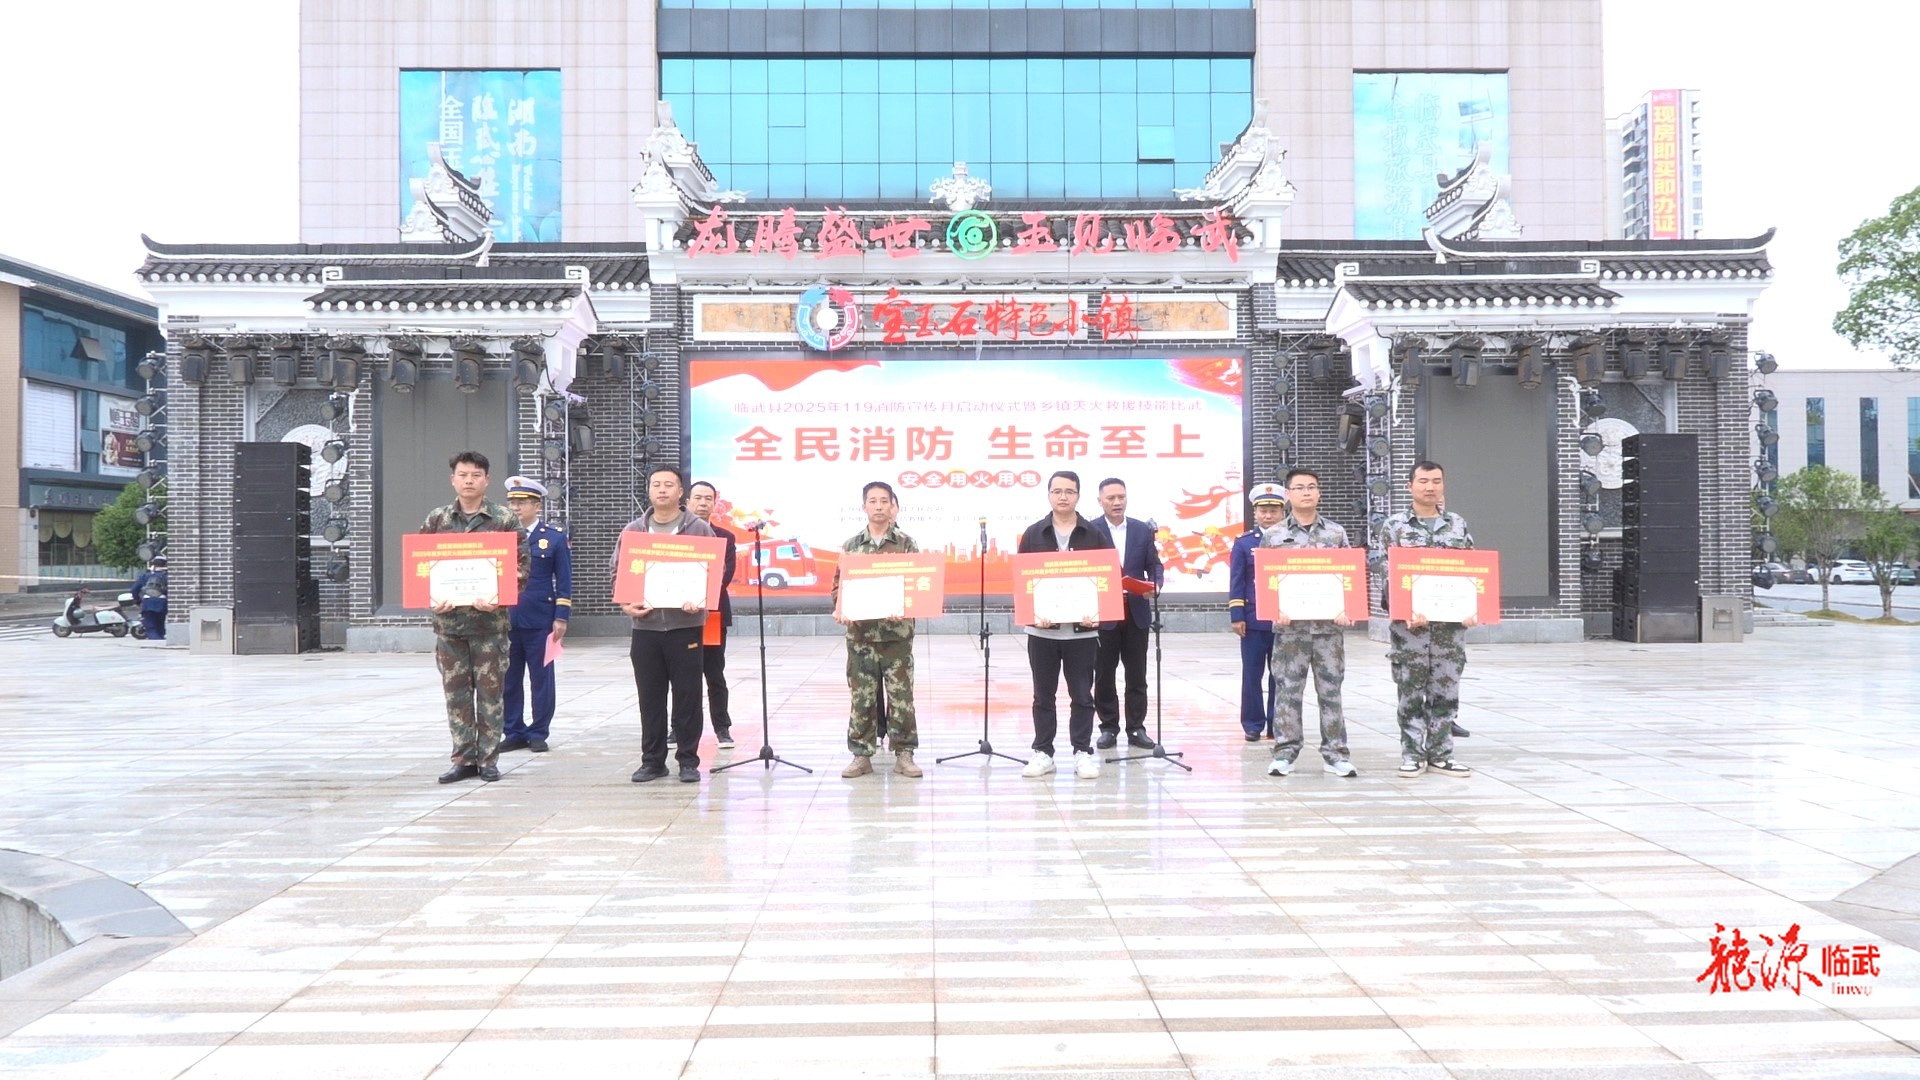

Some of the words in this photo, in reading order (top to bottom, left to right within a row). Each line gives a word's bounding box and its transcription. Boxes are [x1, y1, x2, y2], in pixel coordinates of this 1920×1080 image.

[1653, 105, 1676, 233] 现房即买即办证
[872, 287, 1142, 343] 宝玉石特色小镇
[735, 426, 954, 462] 全民消防
[988, 424, 1205, 461] 生命至上
[900, 472, 1039, 487] 安全用火用电
